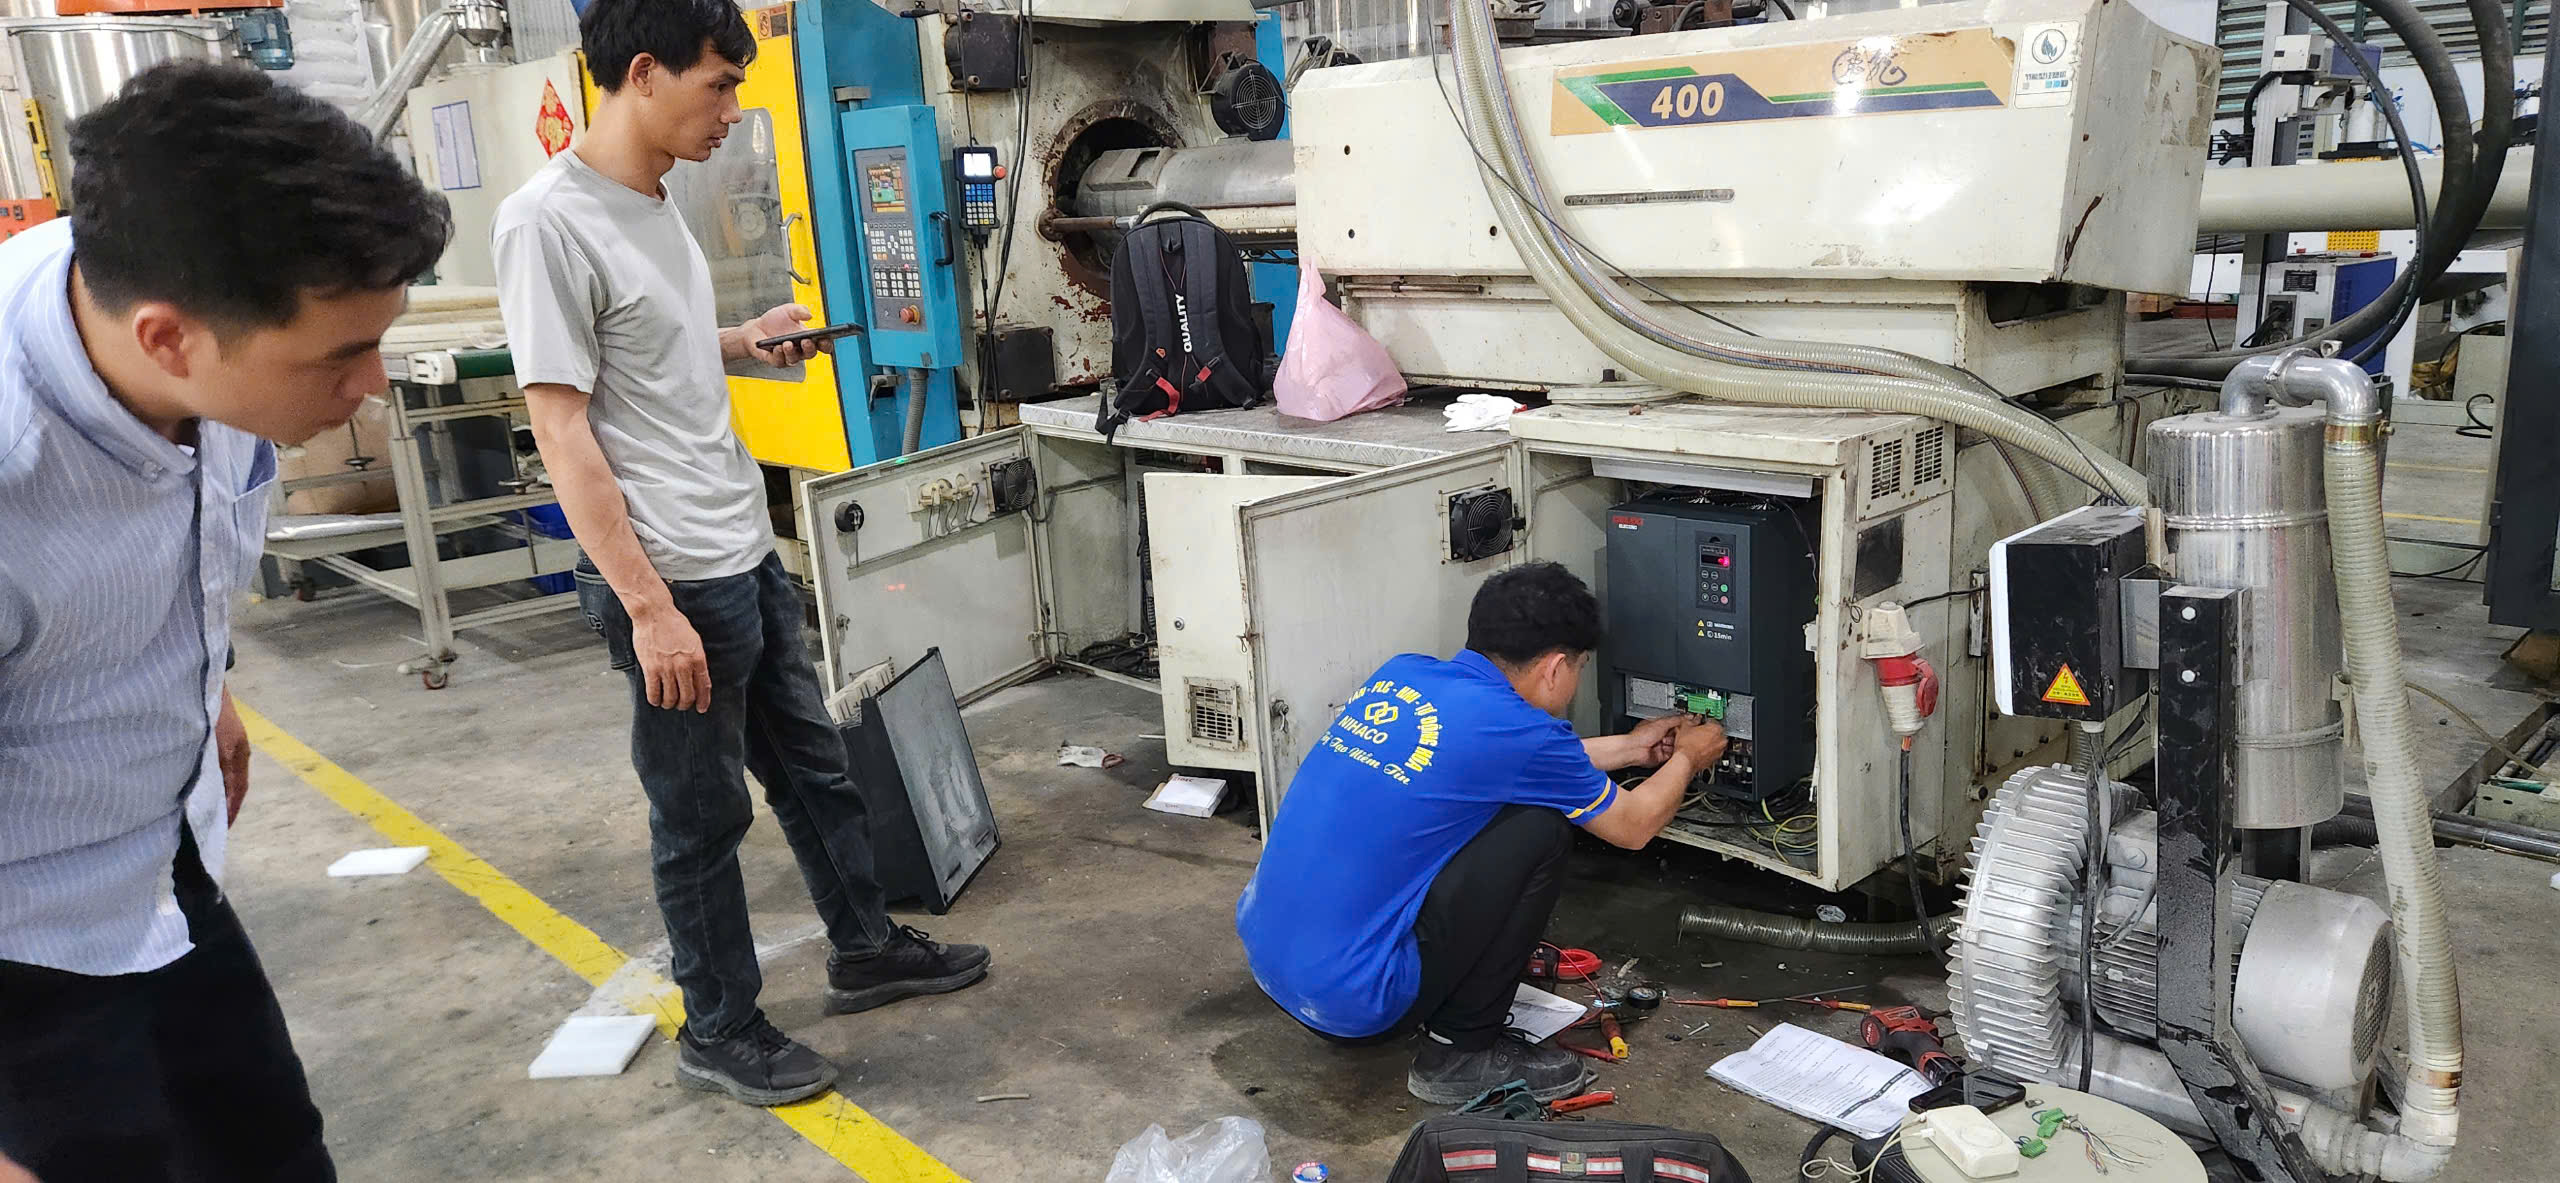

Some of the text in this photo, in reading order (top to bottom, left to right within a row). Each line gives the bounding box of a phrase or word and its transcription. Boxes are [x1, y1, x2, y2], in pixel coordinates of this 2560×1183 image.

[1651, 81, 1724, 120] 400
[1174, 293, 1193, 353] QUALITY
[1371, 680, 1395, 694] PLC
[1338, 715, 1389, 744] NIHACO
[1383, 763, 1411, 785] Tin
